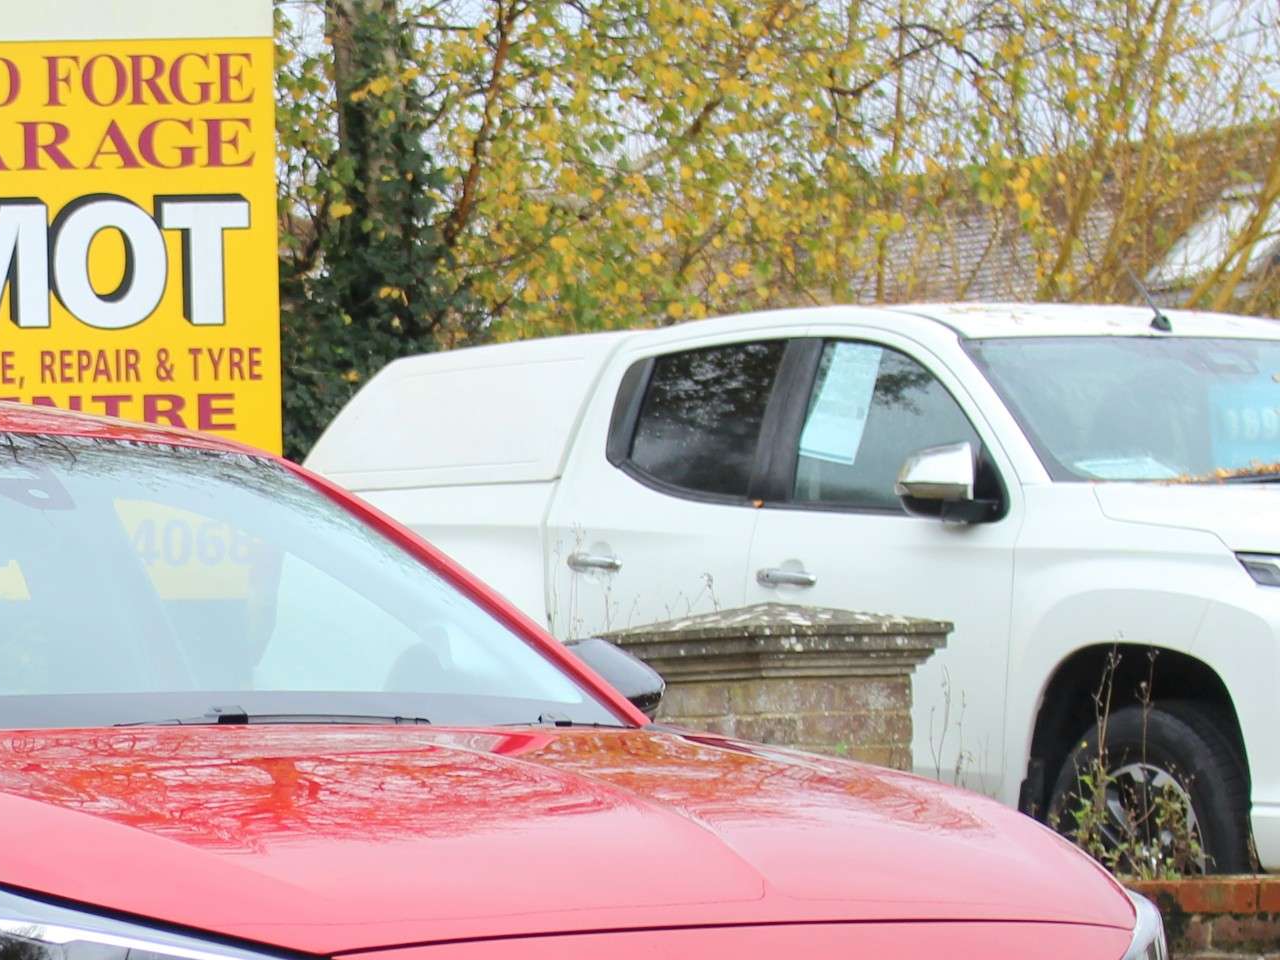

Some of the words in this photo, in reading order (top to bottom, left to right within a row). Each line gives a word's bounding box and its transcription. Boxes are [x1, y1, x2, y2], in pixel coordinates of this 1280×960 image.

[42, 53, 256, 107] FORGE
[40, 349, 141, 383] REPAIR
[156, 348, 175, 382] &
[188, 347, 263, 382] TYRE
